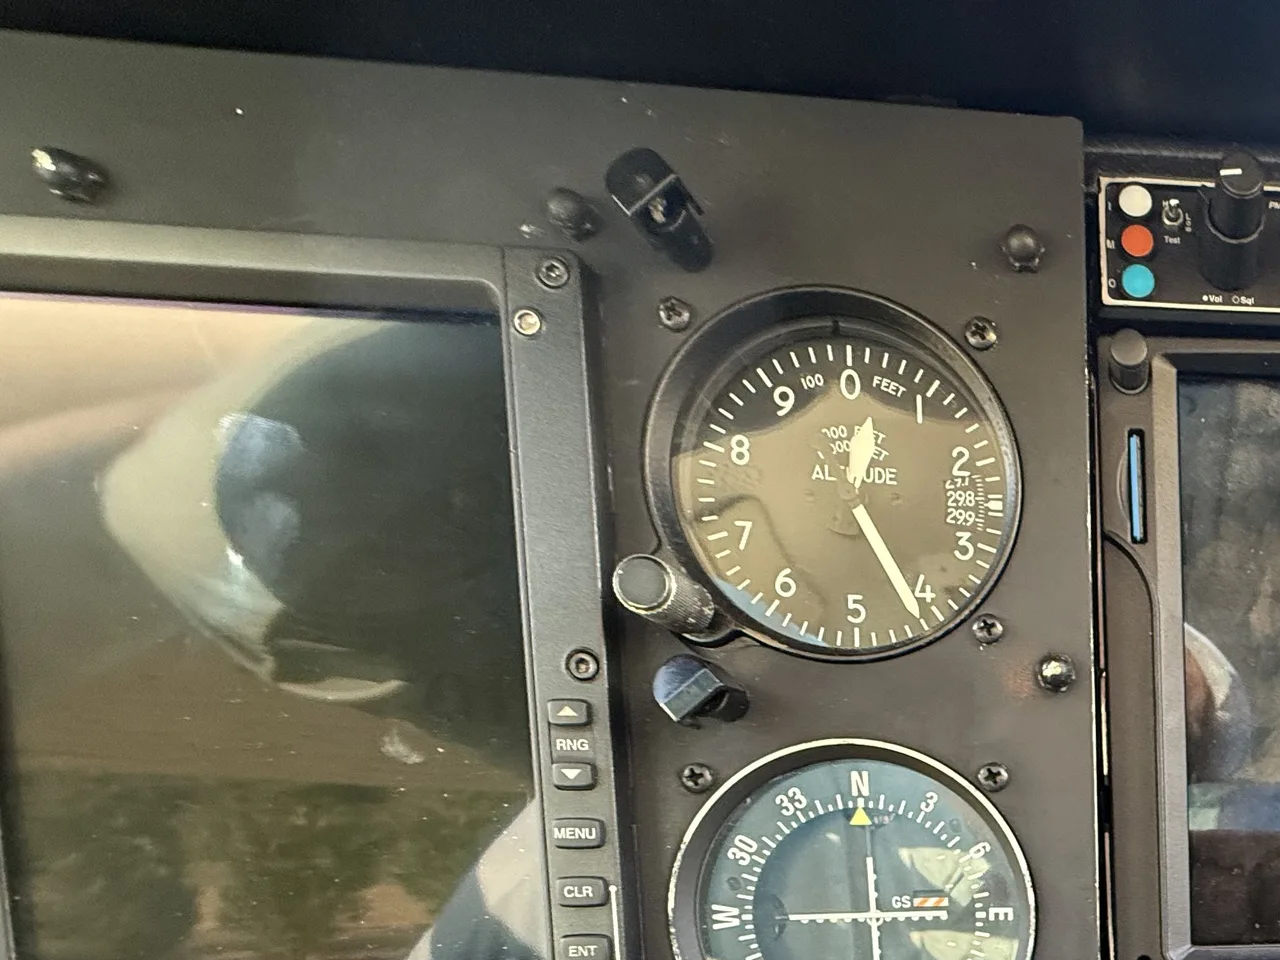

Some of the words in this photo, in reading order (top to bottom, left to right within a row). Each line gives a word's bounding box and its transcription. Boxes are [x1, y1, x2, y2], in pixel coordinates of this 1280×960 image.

[1208, 295, 1223, 304] Vol
[1240, 296, 1254, 305] Sql
[801, 373, 824, 390] 100
[872, 377, 906, 397] FEET
[947, 492, 975, 507] 29.8
[556, 739, 589, 750] RNG
[554, 828, 596, 839] MENU
[564, 886, 593, 897] CLR
[892, 896, 911, 909] GS
[568, 946, 597, 956] ENT
